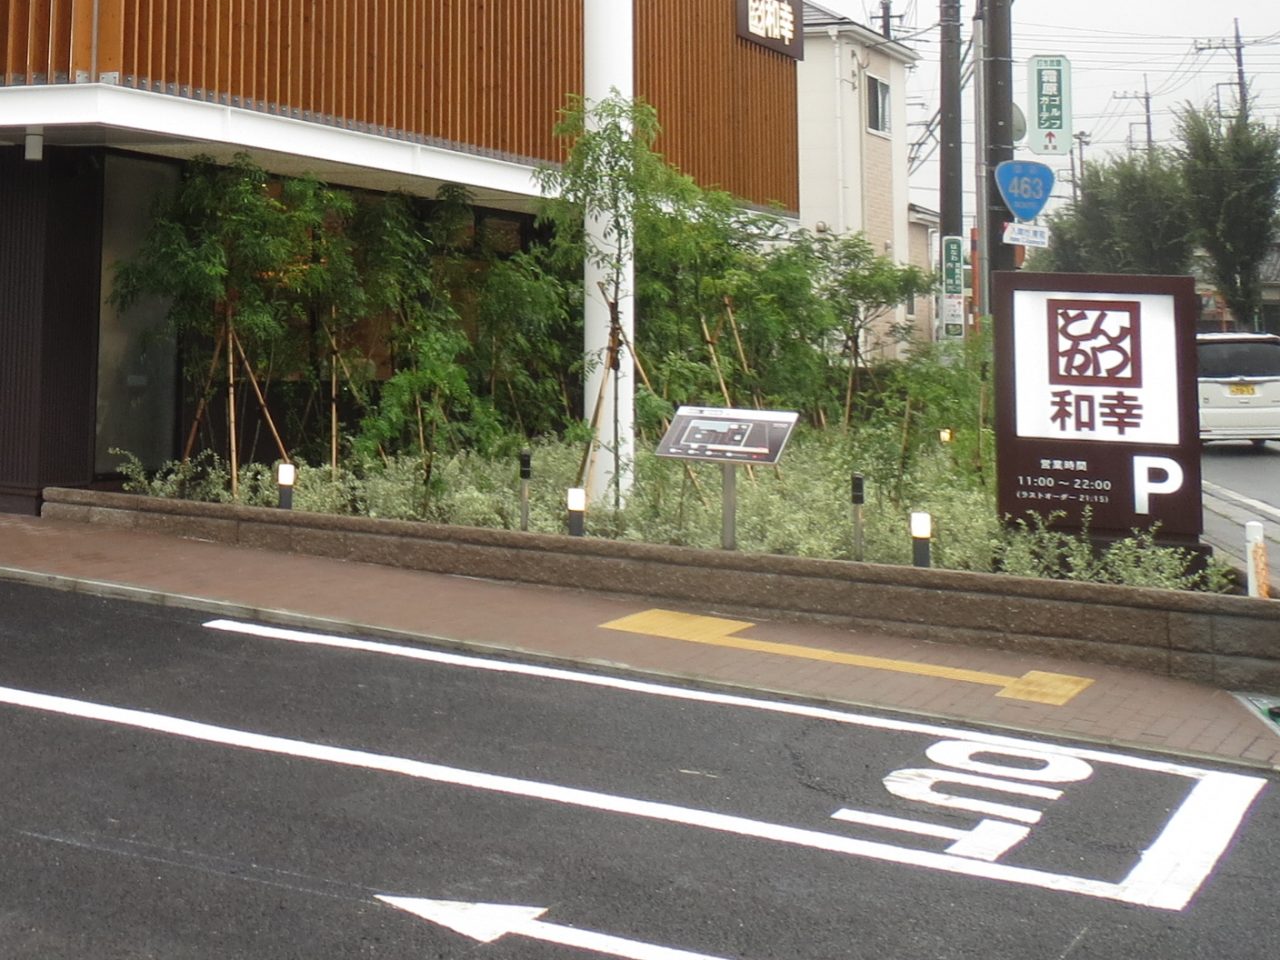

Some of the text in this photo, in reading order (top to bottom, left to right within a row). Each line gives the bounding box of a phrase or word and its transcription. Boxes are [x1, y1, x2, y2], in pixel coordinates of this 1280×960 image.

[1008, 176, 1043, 199] 463
[1050, 390, 1143, 435] 和幸
[1040, 459, 1087, 471] 営業時間
[1017, 475, 1055, 487] 11:00
[1073, 478, 1112, 491] 22:00
[1133, 455, 1184, 515] P
